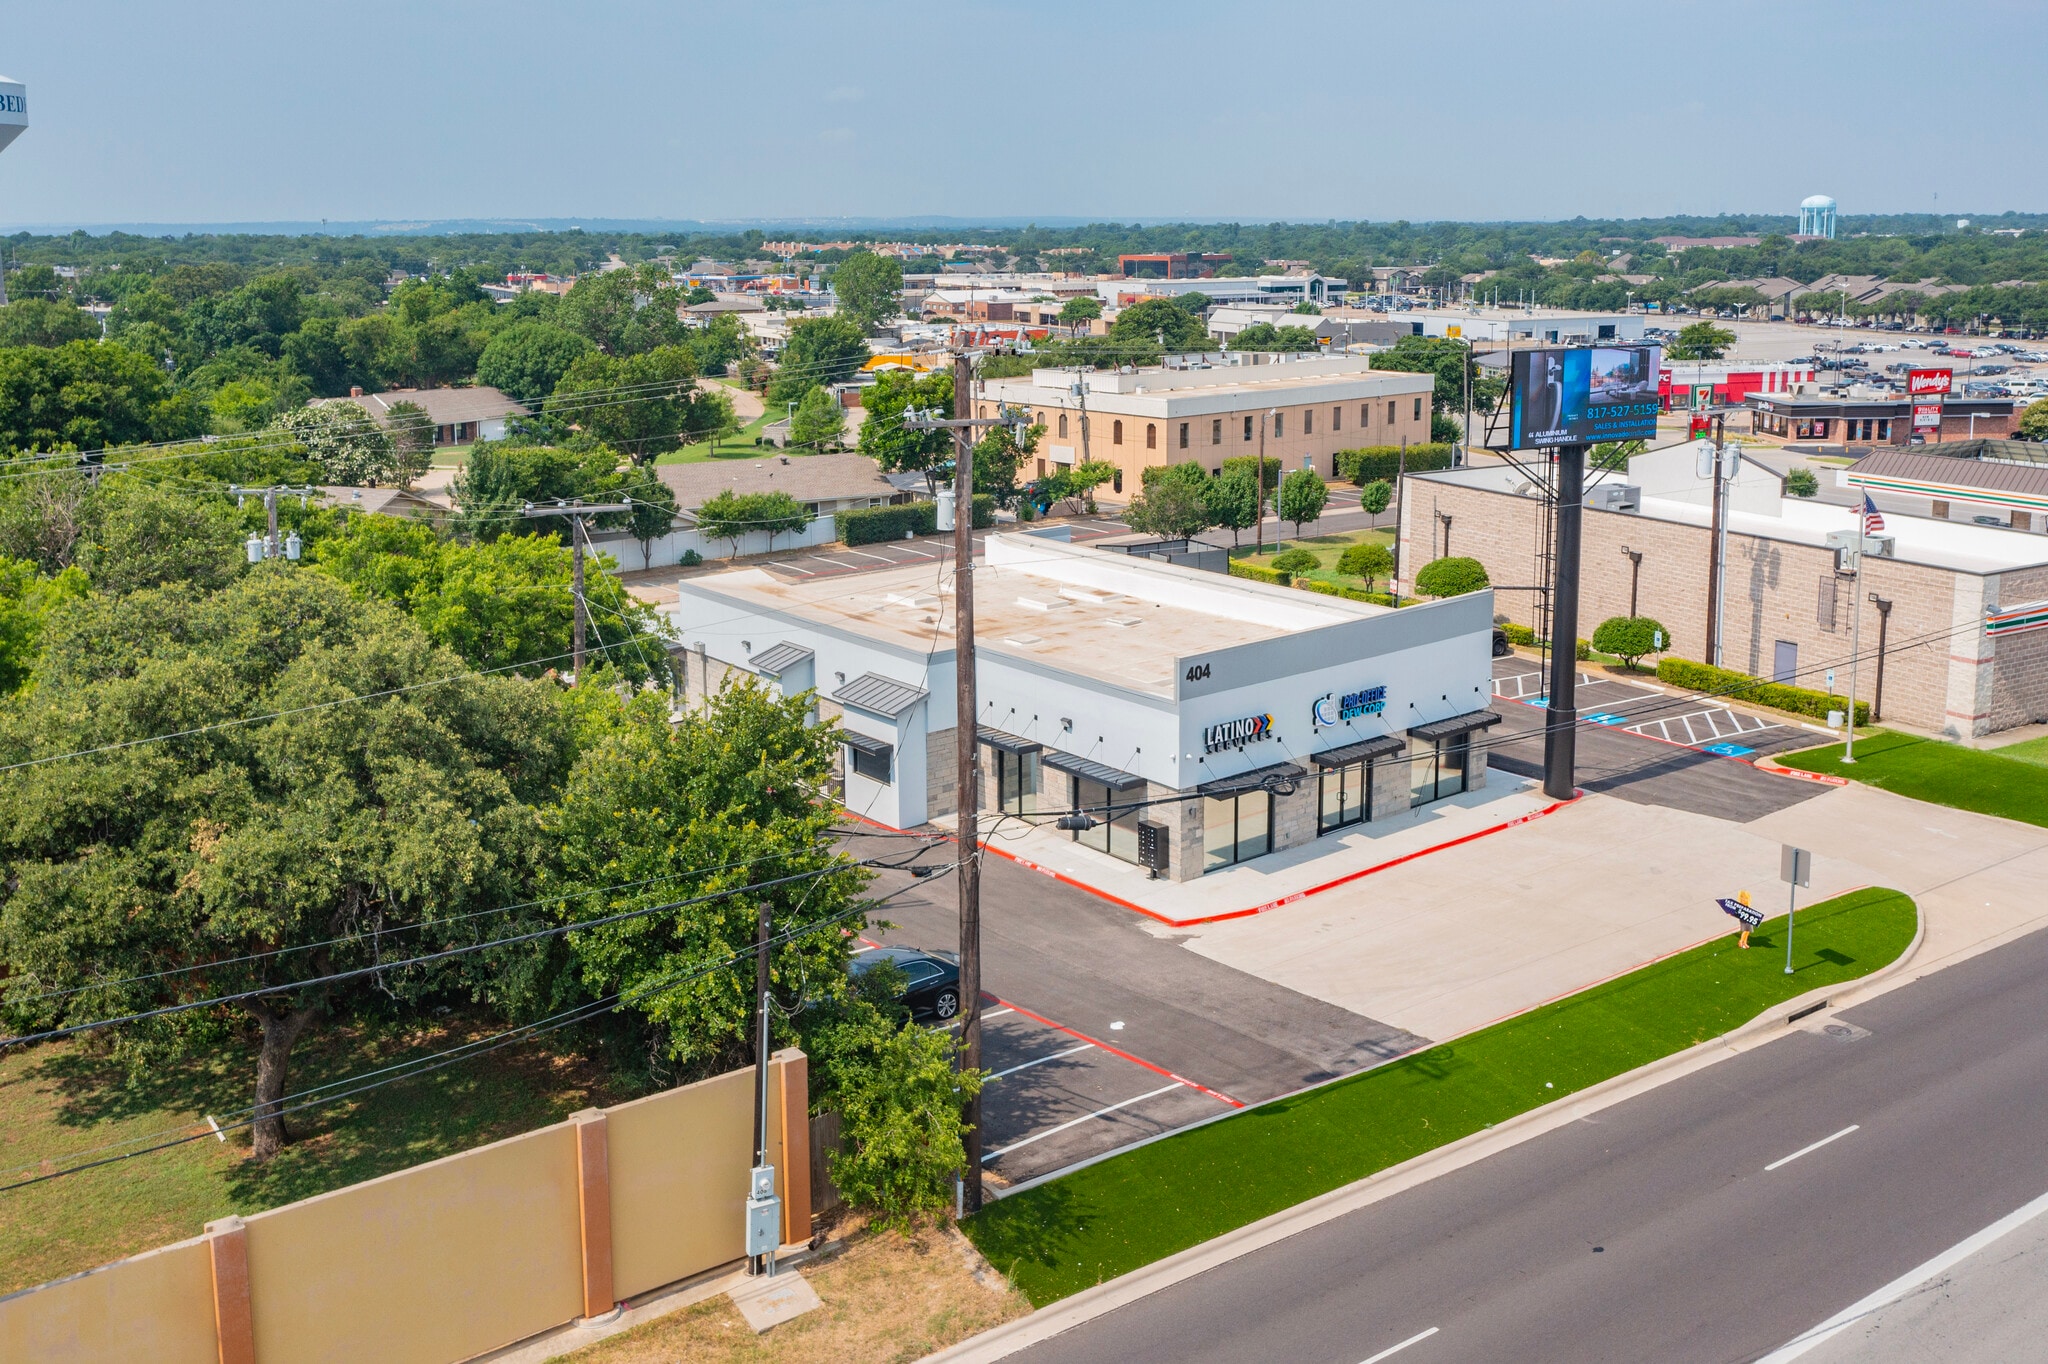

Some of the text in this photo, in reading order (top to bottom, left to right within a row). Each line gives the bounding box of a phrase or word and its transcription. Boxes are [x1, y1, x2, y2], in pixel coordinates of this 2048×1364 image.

[1659, 374, 1670, 382] FC
[1911, 372, 1950, 391] Wendy's
[1587, 403, 1659, 419] 817-527-5159
[1594, 422, 1612, 430] SALES
[1186, 663, 1211, 682] 404
[1363, 701, 1386, 715] CORP
[1206, 718, 1254, 747] LATINO
[1205, 730, 1273, 754] SERVICES
